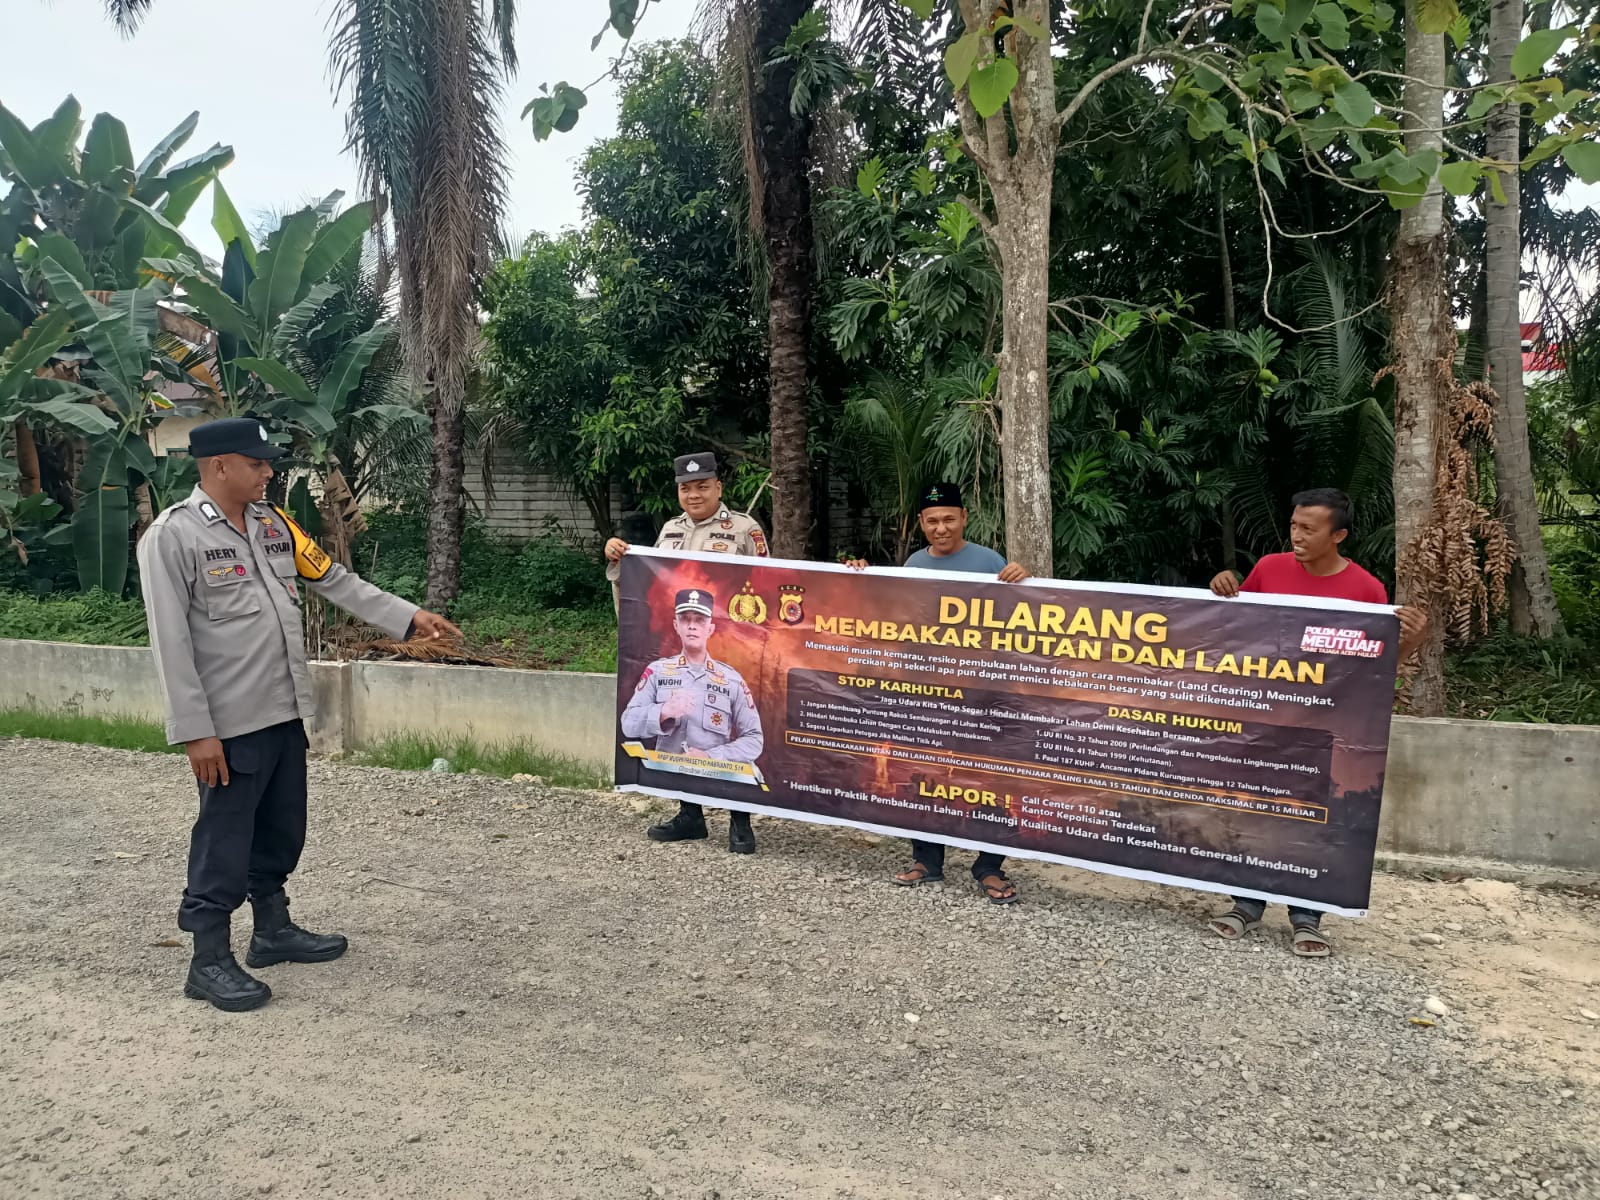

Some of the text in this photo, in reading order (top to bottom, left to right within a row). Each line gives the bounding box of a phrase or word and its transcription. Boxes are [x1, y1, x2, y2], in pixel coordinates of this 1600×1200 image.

[264, 542, 290, 555] POLRI
[710, 532, 735, 541] POLRI
[204, 548, 237, 561] HERY
[939, 595, 1168, 643] DILARANG
[1305, 626, 1362, 638] POLDA ACEH
[814, 615, 1325, 684] MEMBAKAR HUTAN DAN LAHAN
[1301, 634, 1382, 652] MEUTUAH
[805, 641, 1335, 706] Memasuki musim kemarau, resiko pembukaan lahan dengan cara membakar (Land Clearing) Meningkat,
[848, 656, 1273, 711] percikan api sekecil apa pun dapat memicu kebakaran besar yang sulit dikendalikan.
[838, 675, 963, 699] STOP KARHUTLA
[806, 723, 825, 731] Segera
[807, 701, 826, 710] Jangan
[828, 703, 860, 714] Membuang
[960, 720, 978, 728] Lahan
[859, 718, 876, 726] Lahan
[902, 723, 916, 731] Cara
[917, 726, 951, 736] Melakukan
[880, 696, 897, 705] Jaga
[899, 697, 920, 708] Udara
[922, 701, 937, 709] Kita
[939, 702, 960, 713] Tetap
[990, 709, 1019, 720] Hindari
[1021, 713, 1064, 725] Membakar
[1066, 717, 1090, 728] Lahan
[1092, 722, 1114, 732] Demi
[1117, 724, 1160, 737] Kesehatan
[1163, 731, 1202, 743] Bersama.
[1108, 707, 1242, 733] DASAR HUKUM
[1043, 742, 1054, 750] UU
[1064, 745, 1075, 753] No.
[1088, 748, 1108, 757] Tahun
[1110, 751, 1127, 760] 1999
[1129, 754, 1174, 768] (Kehutanan).
[1064, 733, 1075, 741] No.
[1088, 736, 1108, 746] Tahun
[1110, 739, 1127, 748] 2009
[1129, 742, 1179, 756] (Perlindungan
[1180, 749, 1194, 758] dan
[1244, 758, 1289, 770] Lingkungan
[1291, 763, 1320, 774] Hidup).
[790, 735, 816, 745] PELAKU
[817, 739, 865, 752] PEMBAKARAN
[866, 745, 891, 755] HUTAN
[892, 749, 909, 758] DAN
[910, 752, 935, 762] LAHAN
[937, 756, 972, 767] DIANCAM
[975, 762, 1015, 773] HUKUMAN
[1017, 767, 1051, 779] PENJARA
[1053, 773, 1081, 783] PALING
[1083, 778, 1107, 787] LAMA
[1120, 783, 1150, 793] TAHUN
[1152, 788, 1171, 796] DAN
[1173, 791, 1204, 801] DENDA
[1206, 796, 1254, 809] MAKSIMAL
[1256, 802, 1269, 810] RP
[1283, 806, 1316, 818] MILIAR
[1042, 754, 1059, 762] Pasal
[1074, 758, 1095, 767] KUHP
[1100, 762, 1132, 774] Ancaman
[1134, 767, 1158, 777] Pidana
[1160, 770, 1195, 783] Kurungan
[1197, 776, 1224, 787] Hingga
[1238, 782, 1260, 791] Tahun
[1262, 785, 1293, 796] Penjara.
[918, 781, 997, 807] LAPOR
[1022, 795, 1121, 818] Call Center 110 atau
[790, 781, 1318, 879] Hentikan Praktik Pembakaran Lahan Lindungi Kualitas Udara dan Kesehatan Generasi Mendatang
[1022, 805, 1156, 834] Kantor Kepolisian Terdekat
